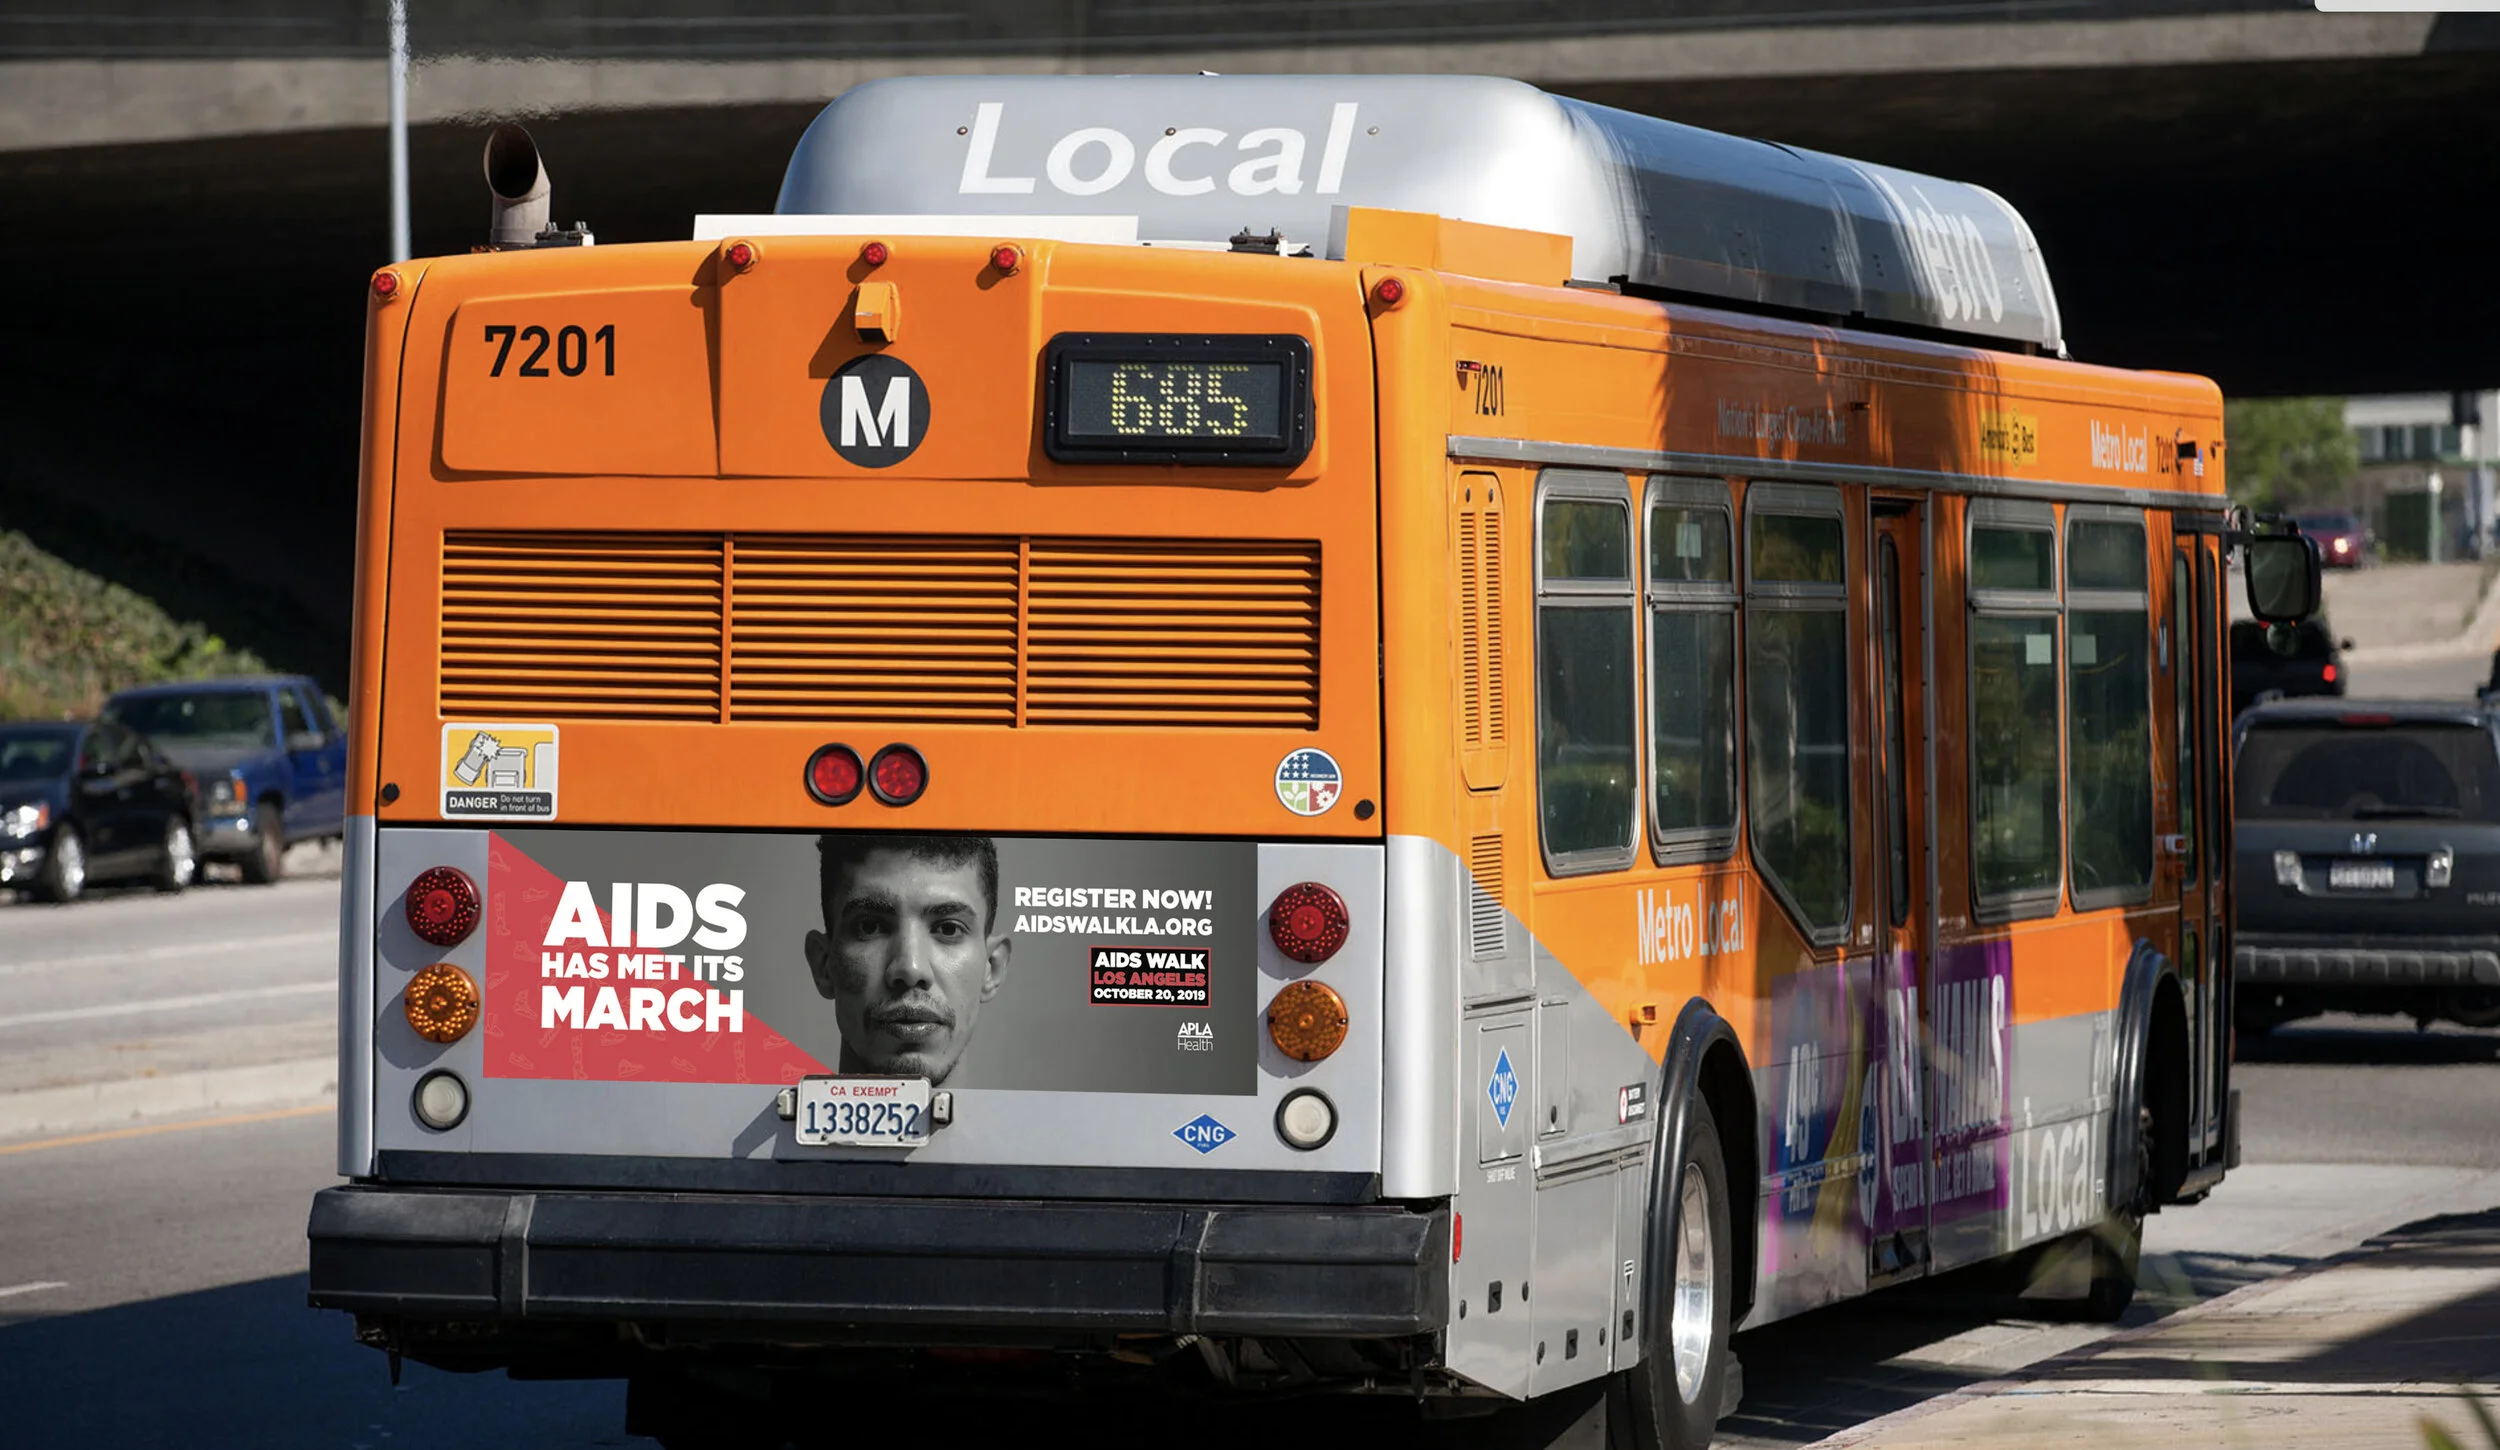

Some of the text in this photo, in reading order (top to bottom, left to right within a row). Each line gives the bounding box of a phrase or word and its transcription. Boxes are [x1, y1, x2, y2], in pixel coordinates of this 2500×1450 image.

[958, 102, 1358, 196] Local
[485, 324, 614, 377] 7201
[1112, 364, 1248, 435] 685
[1474, 364, 1504, 416] 7201
[840, 375, 910, 447] M
[2090, 419, 2148, 473] Metro Local
[449, 796, 498, 808] DANGER
[500, 794, 512, 802] Do
[513, 795, 524, 803] not
[509, 804, 527, 812] front
[537, 804, 550, 812] bus
[1014, 887, 1212, 910] REGISTER NOW!
[542, 881, 747, 950] AIDS
[1014, 915, 1212, 935] AIDSWALKLA.ORG
[1637, 877, 1744, 966] Metro Local
[541, 952, 744, 982] HAS MET ITS
[1095, 952, 1205, 969] AIDS WALK
[1094, 971, 1206, 986] LOS ANGELES
[541, 985, 743, 1033] MARCH
[1094, 988, 1205, 1002] OCTOBER 20, 2019
[1177, 1022, 1212, 1036] APLA
[1177, 1037, 1213, 1051] Health
[830, 1086, 899, 1097] CA EXEMPT
[1493, 1071, 1513, 1105] CNG
[804, 1101, 920, 1135] 1338252
[1184, 1125, 1225, 1142] CNG
[2021, 1080, 2101, 1241] Local
